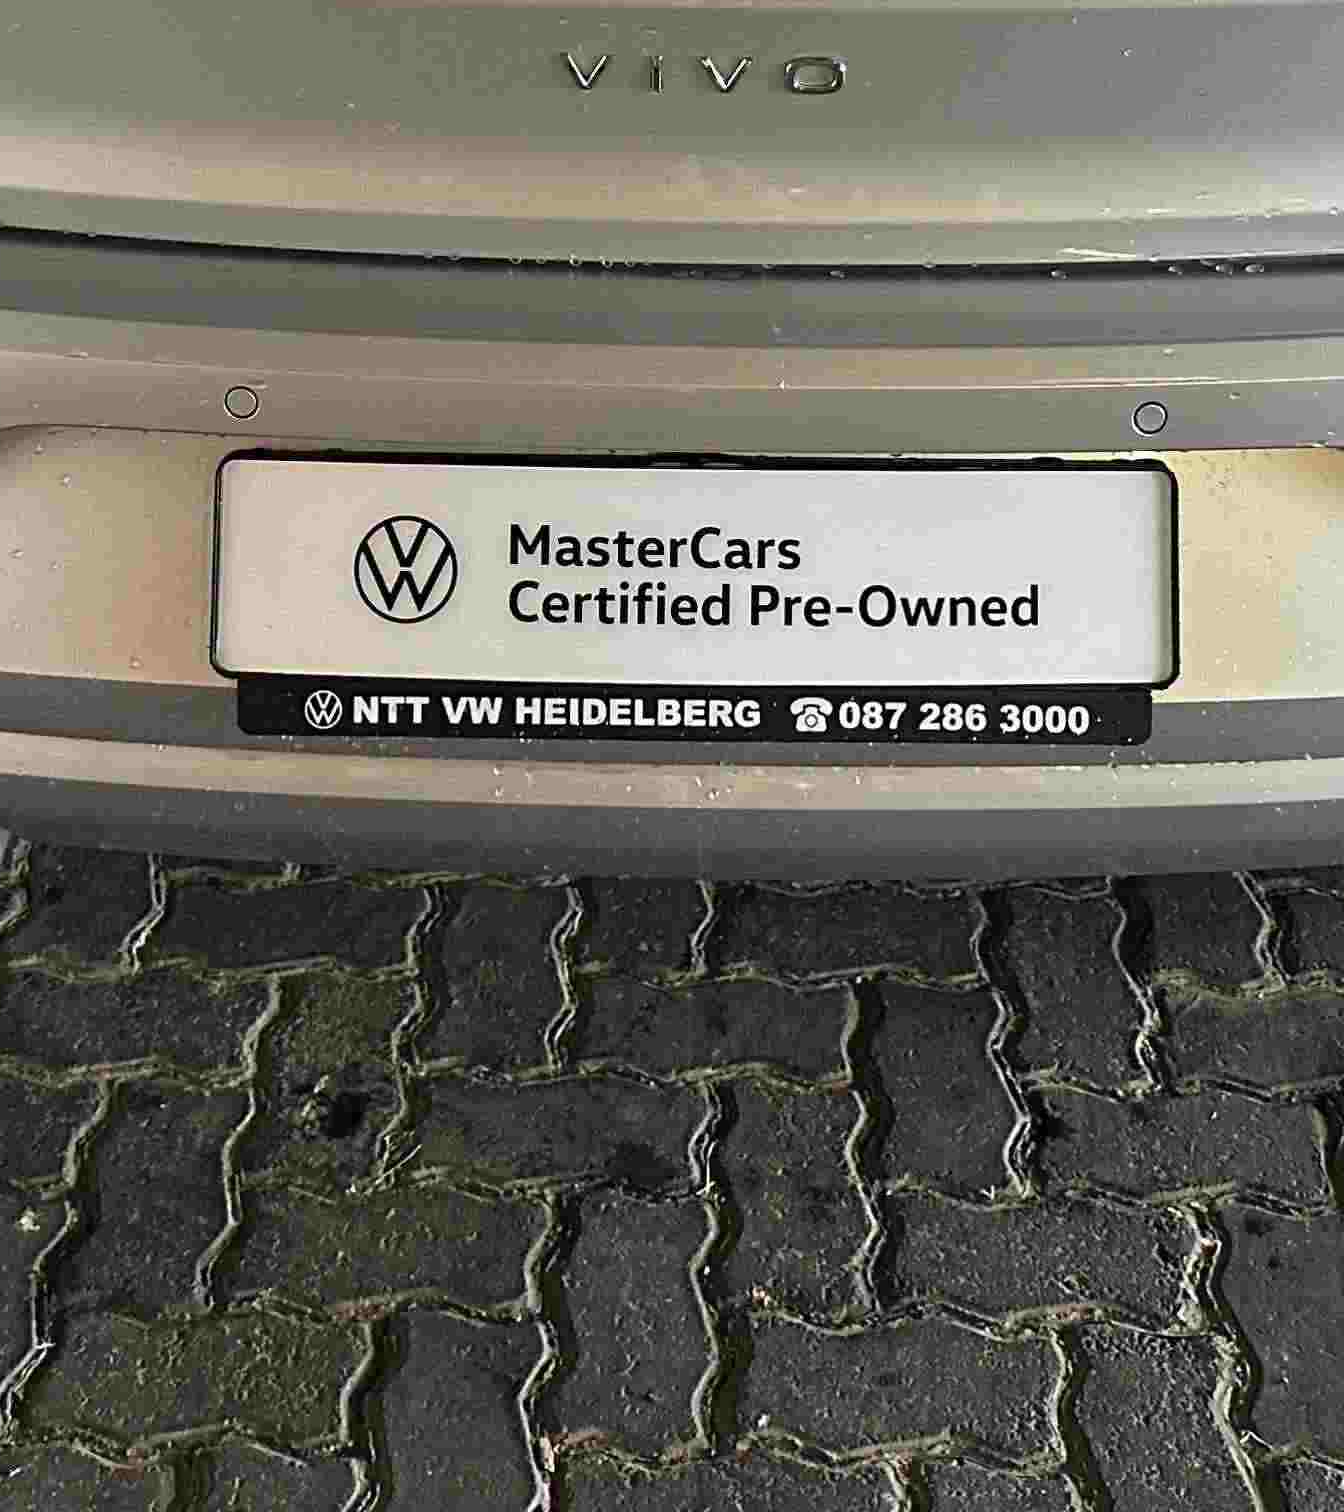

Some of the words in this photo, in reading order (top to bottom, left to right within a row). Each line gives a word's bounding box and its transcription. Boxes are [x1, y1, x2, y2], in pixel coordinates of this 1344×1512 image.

[509, 524, 801, 570] MasterCars
[509, 580, 730, 626] Certified
[750, 584, 1039, 627] Pre-Owned
[353, 695, 430, 725] NTT
[442, 696, 502, 726] VW
[515, 697, 761, 728] HEIDELBERG
[838, 701, 907, 731] 087
[919, 703, 987, 732] 286
[999, 704, 1090, 735] 3000
